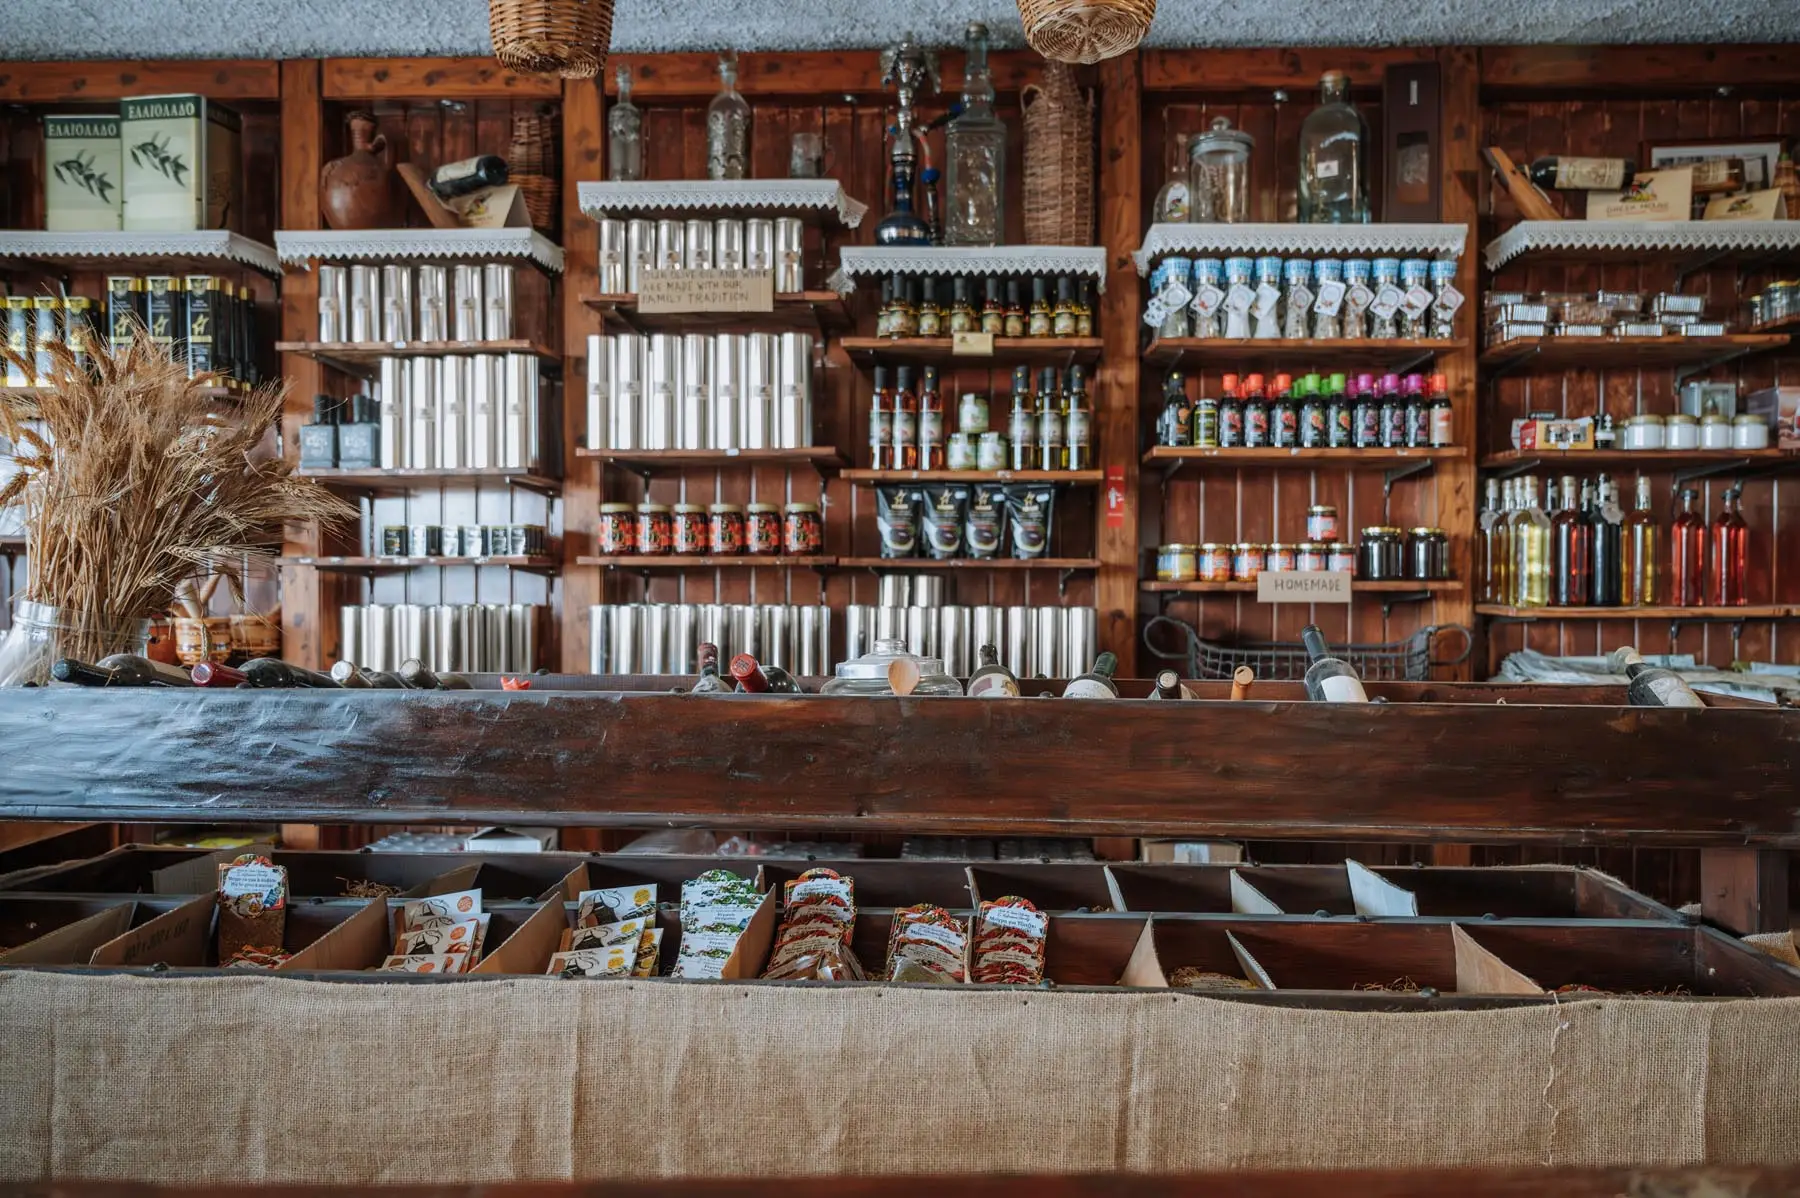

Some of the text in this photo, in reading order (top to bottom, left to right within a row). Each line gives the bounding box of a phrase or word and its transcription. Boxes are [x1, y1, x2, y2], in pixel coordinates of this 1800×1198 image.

[127, 101, 196, 119] ΕΛΑΙΟΛΑΔΟ
[48, 122, 118, 137] ΕΛΑΙΟΛΑΔΟ
[643, 271, 667, 280] OUR
[671, 270, 695, 280] OLIVE
[719, 270, 738, 279] AND
[742, 270, 768, 279] WINE
[642, 280, 742, 293] ARE MADE WITH OUR
[642, 292, 749, 305] FAMILY TRADITION
[1274, 579, 1341, 592] HOMEMADE
